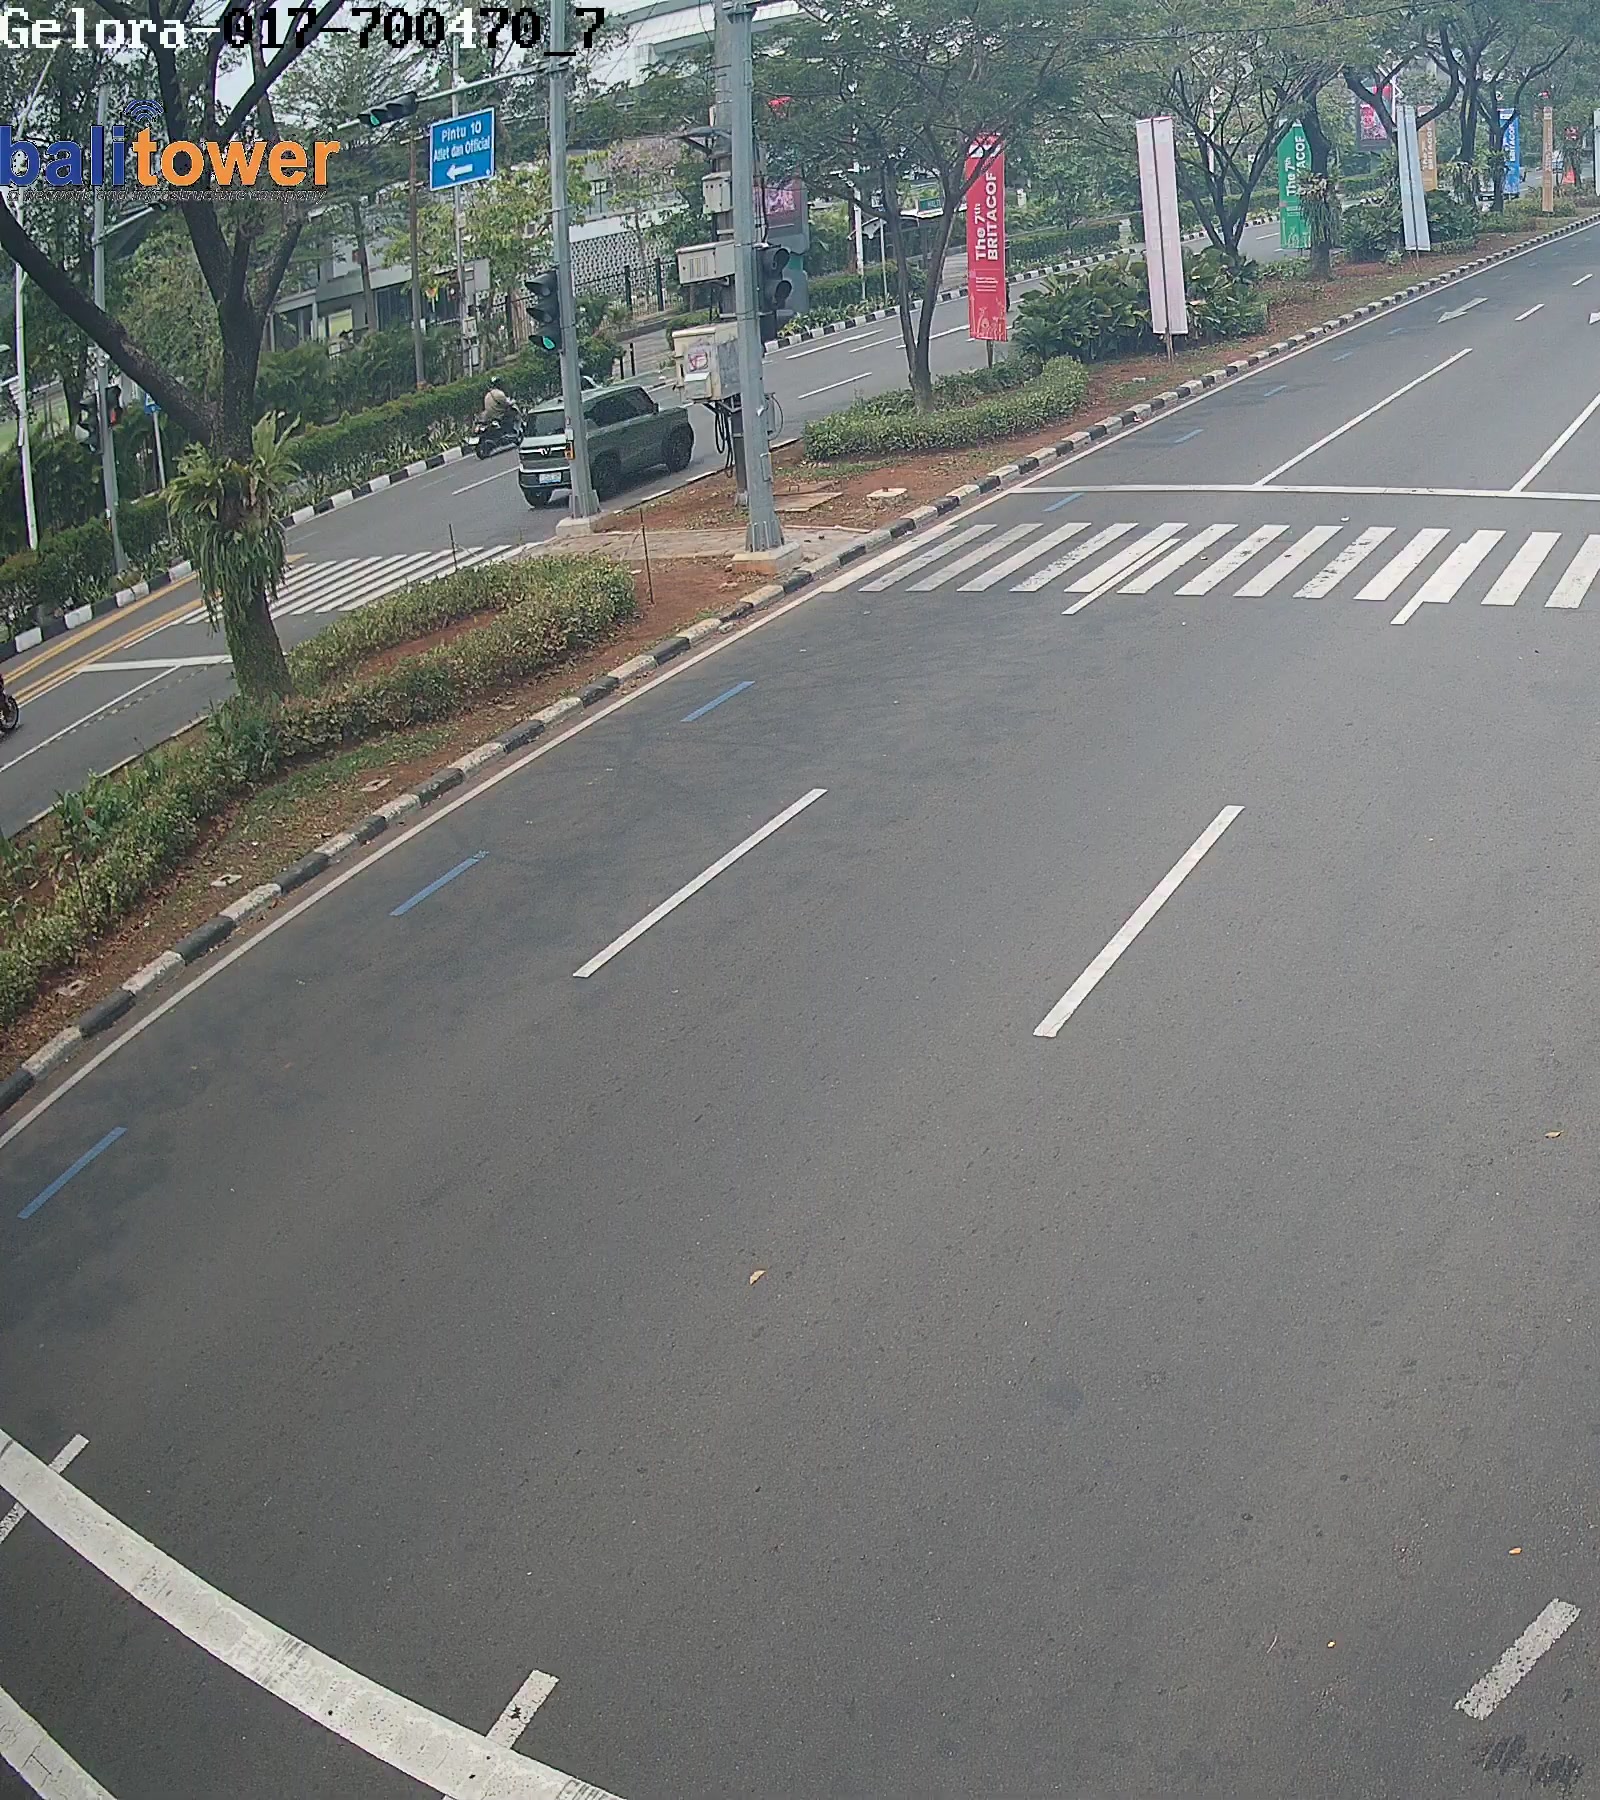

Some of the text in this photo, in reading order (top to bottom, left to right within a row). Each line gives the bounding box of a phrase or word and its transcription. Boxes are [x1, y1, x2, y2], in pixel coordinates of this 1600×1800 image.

[441, 120, 482, 143] Pintu 10
[450, 143, 464, 158] dan
[464, 135, 491, 155] Official
[1284, 156, 1296, 172] 7th
[1286, 173, 1296, 197] The
[973, 202, 986, 225] 7th
[984, 171, 998, 261] BRITACOF
[974, 225, 987, 261] The
